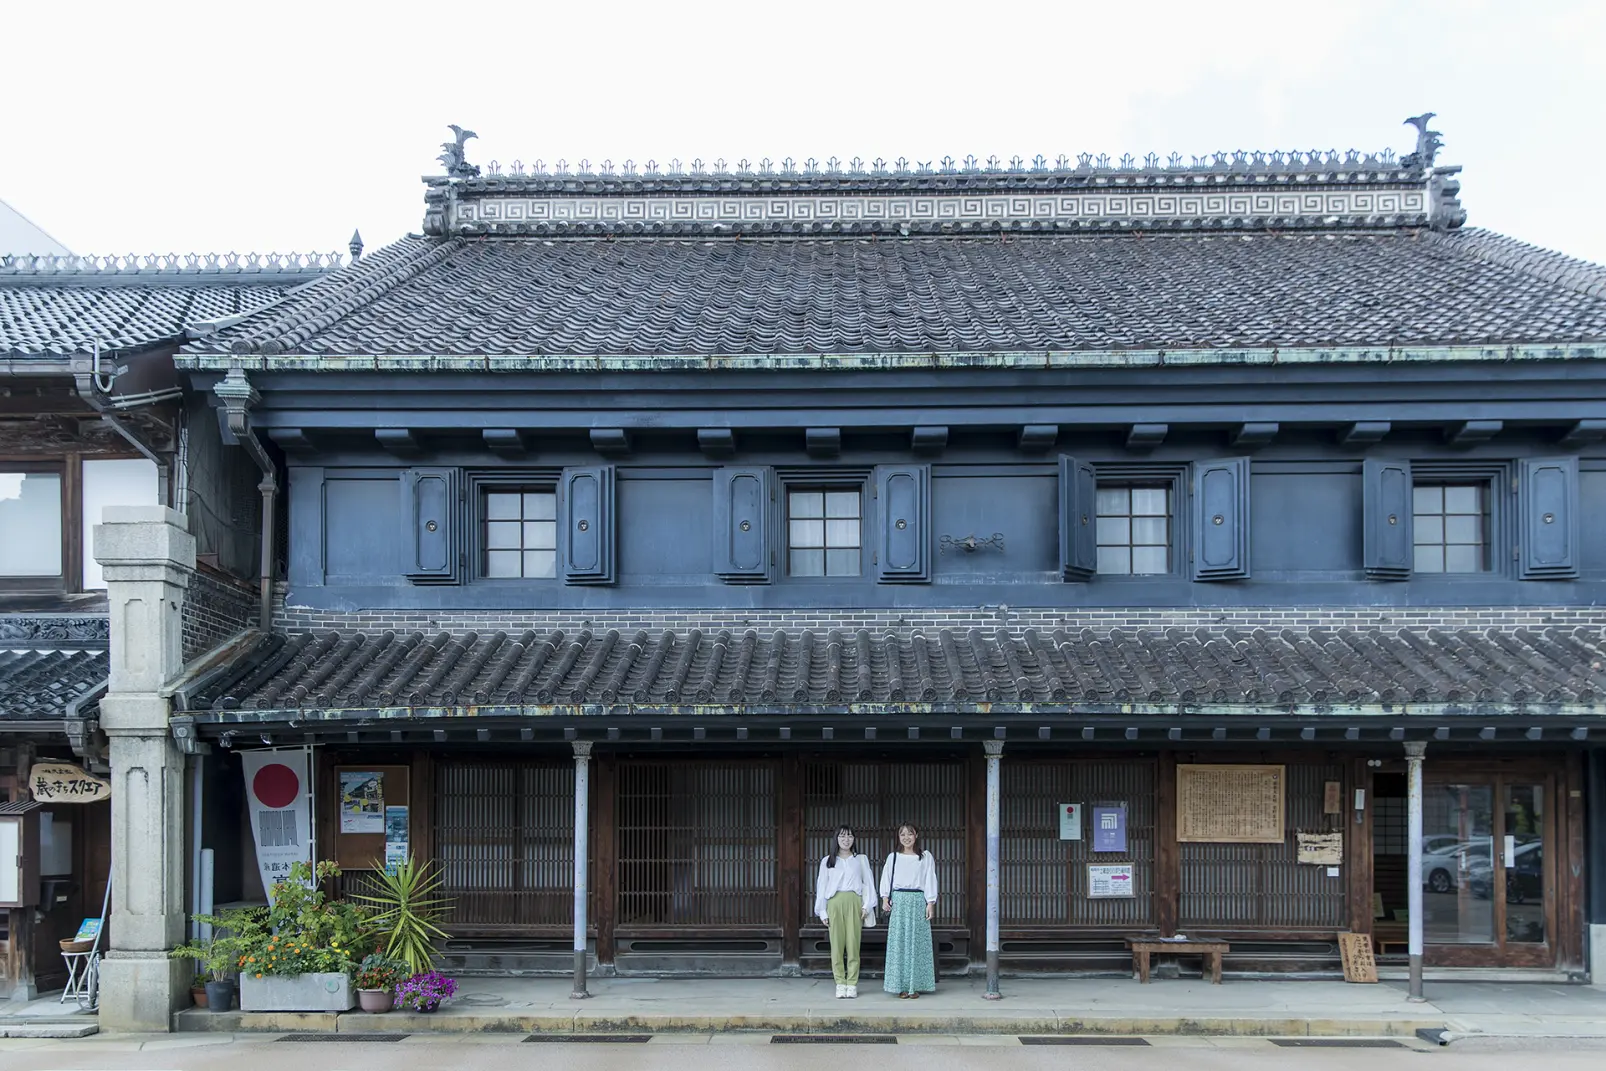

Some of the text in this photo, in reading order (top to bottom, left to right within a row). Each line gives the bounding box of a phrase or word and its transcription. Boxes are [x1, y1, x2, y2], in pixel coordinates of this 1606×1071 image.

[36, 777, 103, 798] 蔵のまちスクエア
